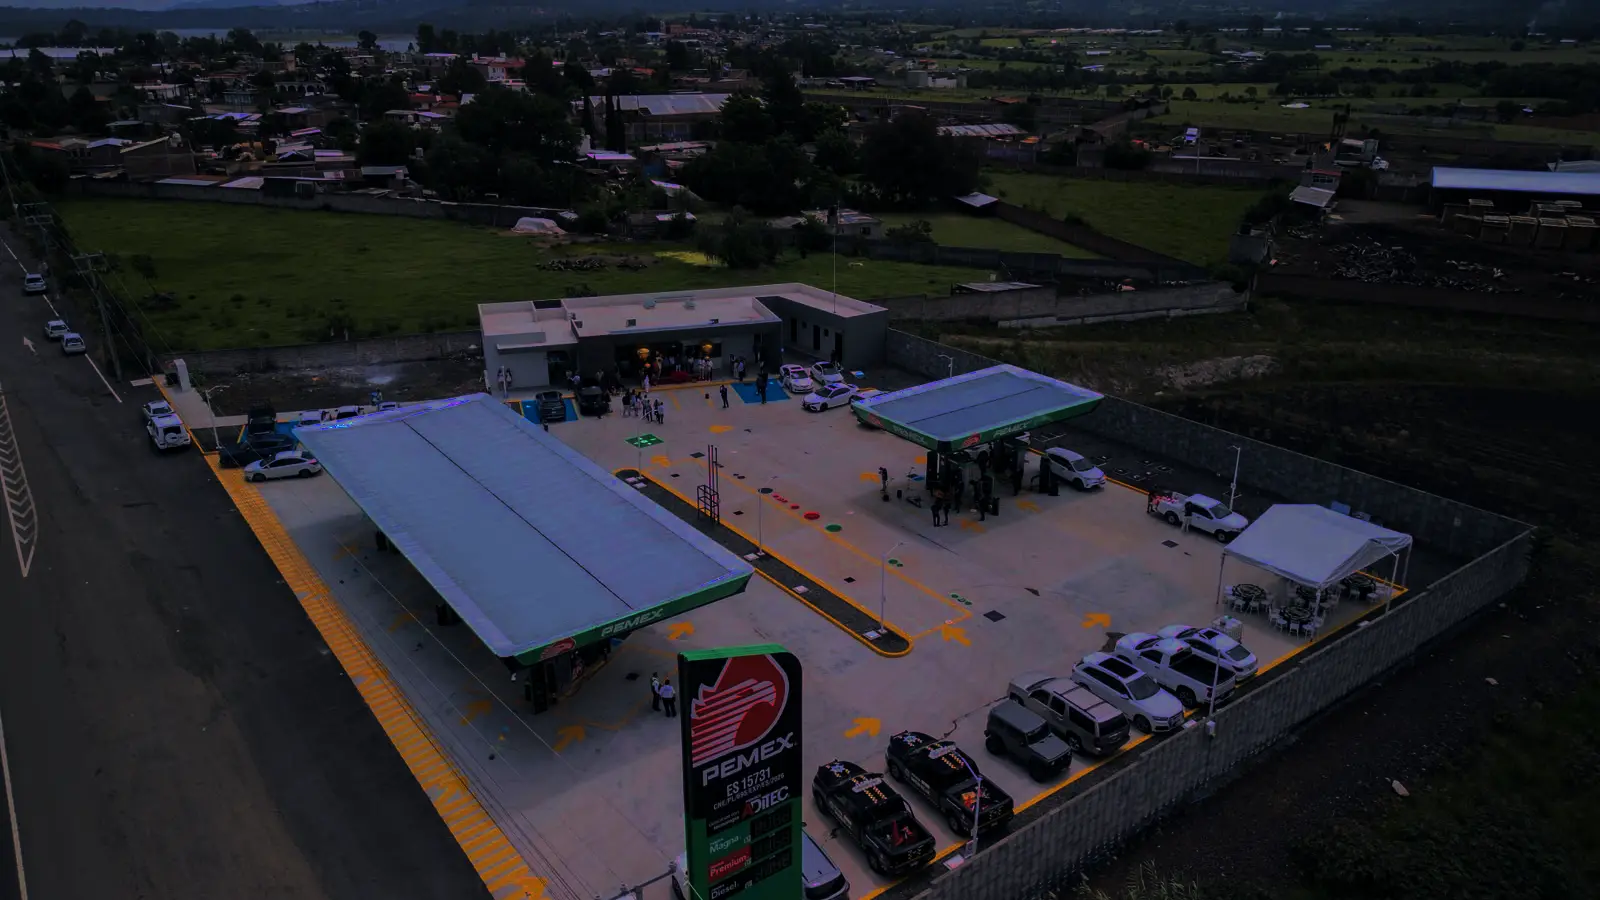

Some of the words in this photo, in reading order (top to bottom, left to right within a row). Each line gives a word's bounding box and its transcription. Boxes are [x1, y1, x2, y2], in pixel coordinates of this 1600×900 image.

[601, 608, 663, 637] PEMEX
[702, 732, 794, 786] PEMEX
[726, 781, 740, 797] ES
[741, 767, 771, 790] 15731
[709, 835, 739, 854] Magna
[709, 855, 747, 877] Premium
[711, 881, 737, 900] Diesel
